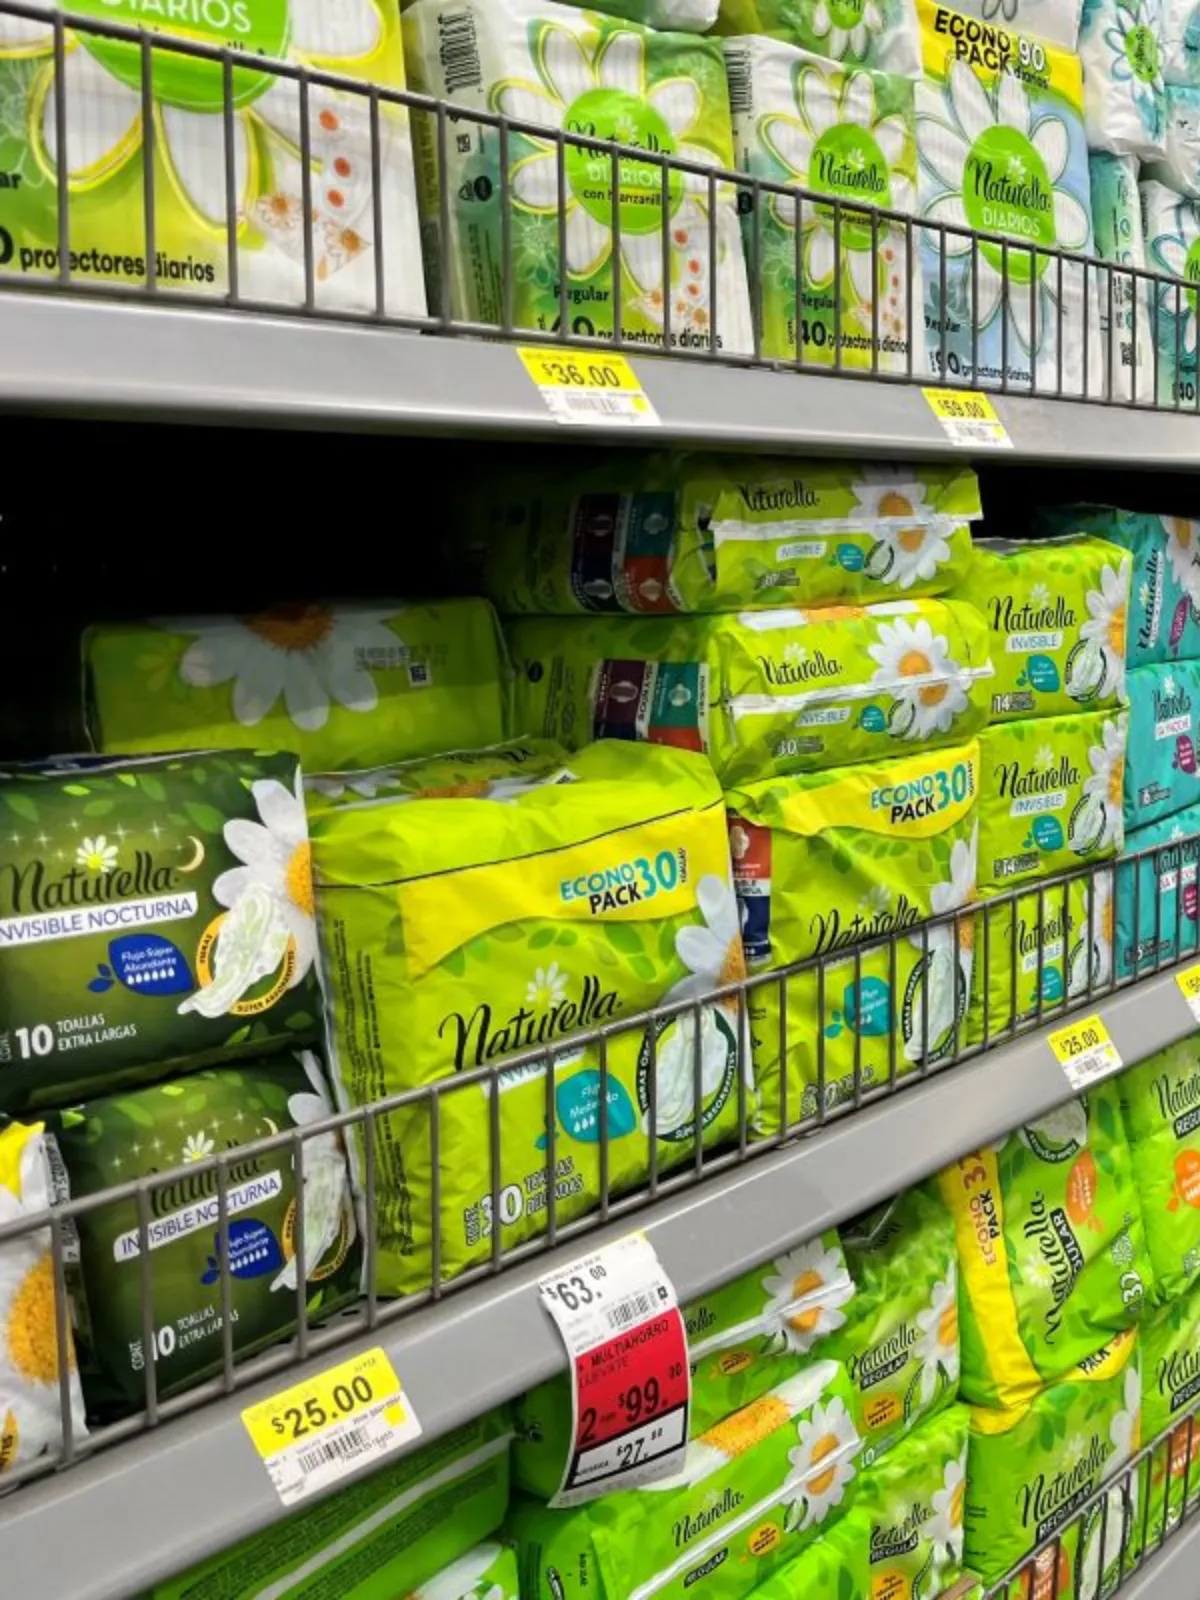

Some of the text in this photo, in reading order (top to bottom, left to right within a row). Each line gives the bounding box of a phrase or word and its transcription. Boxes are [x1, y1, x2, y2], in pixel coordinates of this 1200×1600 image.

[935, 9, 1010, 52] ECONO
[955, 39, 1012, 76] PACK
[1019, 39, 1045, 71] 90
[813, 149, 886, 194] Naturella
[967, 157, 1051, 212] Naturella
[983, 209, 1040, 237] DIARIOS
[542, 363, 620, 387] $36.00
[987, 595, 1077, 633] Naturella
[758, 650, 842, 685] Naturella
[871, 775, 934, 810] ECONO
[935, 762, 968, 810] 30
[994, 756, 1080, 799] Naturella
[890, 794, 936, 825] PACK
[0, 850, 180, 913] Naturella
[560, 863, 634, 902] ECONO
[634, 849, 678, 898] 30
[88, 898, 194, 930] NOCTURNA
[589, 881, 642, 915] PACK
[14, 1024, 53, 1060] 10
[56, 1013, 106, 1034] TOALLAS
[57, 1023, 138, 1051] EXTRA LARGAS
[437, 973, 623, 1073] Naturella
[1061, 1027, 1099, 1057] $25.00
[982, 1188, 1002, 1240] PACK
[846, 1324, 920, 1381] Naturella
[861, 1354, 908, 1390] REGULAR
[271, 1375, 373, 1439] $25.00
[1016, 1433, 1110, 1528] Naturella
[672, 1487, 745, 1548] Naturella
